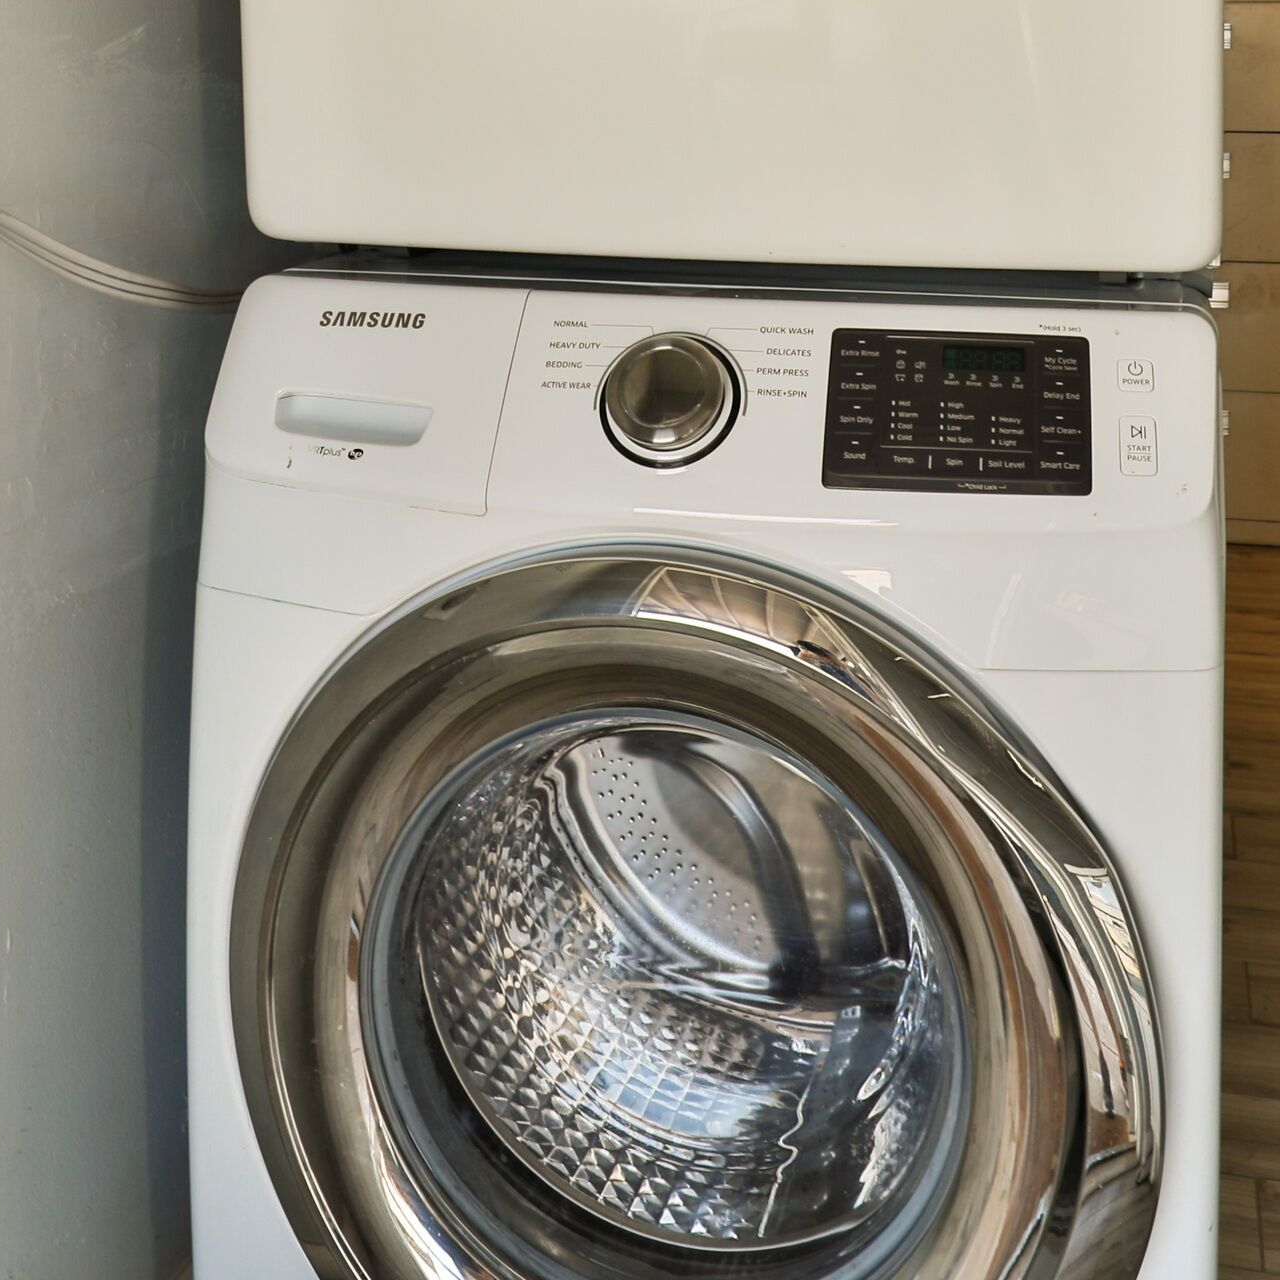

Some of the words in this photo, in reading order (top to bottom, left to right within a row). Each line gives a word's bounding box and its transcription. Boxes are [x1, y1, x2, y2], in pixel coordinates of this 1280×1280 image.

[319, 310, 426, 330] SAMSUNG
[553, 320, 589, 328] NORMAL
[759, 326, 786, 334] QUICK
[788, 327, 815, 335] WASH
[549, 341, 577, 349] HEAVY
[578, 342, 601, 350] DUTY
[766, 348, 812, 357] DELICATES
[840, 349, 860, 357] Extra
[860, 350, 881, 358] Rinse
[545, 360, 583, 369] BEDDING
[1044, 356, 1056, 365] My
[1057, 357, 1078, 365] Cycle
[756, 367, 781, 375] PERM
[782, 368, 809, 377] PRESS
[541, 381, 568, 389] ACTIVE
[568, 382, 592, 390] WEAR
[840, 382, 860, 390] Extra
[860, 383, 877, 391] Spin
[1122, 378, 1151, 386] POWER
[757, 388, 808, 398] RINSE+SPIN
[1043, 391, 1065, 401] Delay
[1065, 392, 1081, 400] End
[898, 399, 912, 407] Hot
[947, 402, 964, 410] High
[898, 411, 919, 419] Warm
[947, 413, 976, 421] Medium
[839, 415, 856, 424] Spin
[856, 416, 874, 425] Only
[998, 416, 1022, 425] Heavy
[897, 422, 913, 430] Cool
[1040, 425, 1055, 434] Self
[998, 427, 1025, 436] Normal
[896, 433, 913, 441] Cold
[958, 436, 974, 444] Spin
[998, 439, 1017, 448] Light
[1127, 444, 1152, 453] START
[843, 451, 866, 460] Sound
[1127, 454, 1152, 463] PAUSE
[945, 457, 964, 467] Spin
[988, 459, 1003, 468] Soil
[1004, 461, 1026, 469] Level
[1040, 461, 1063, 470] Smart
[1063, 462, 1081, 471] Care
